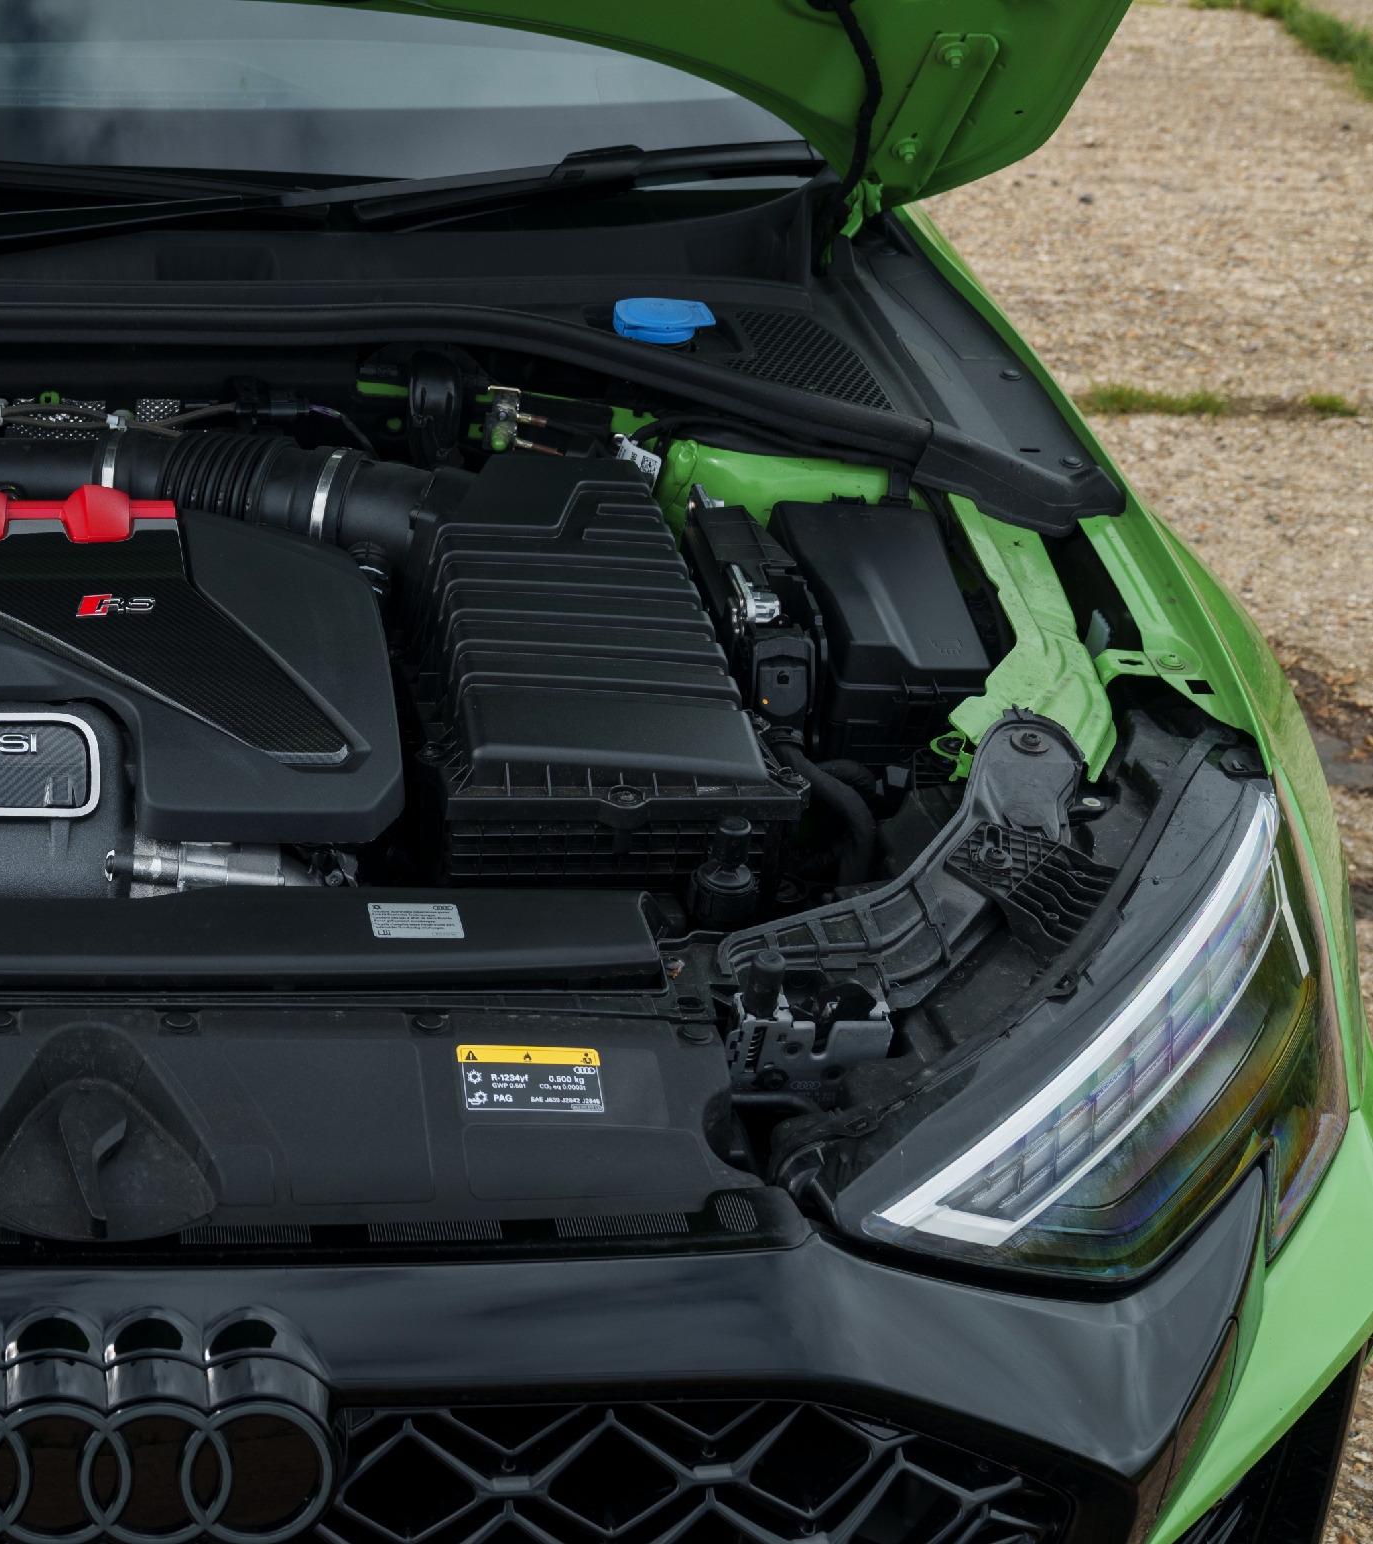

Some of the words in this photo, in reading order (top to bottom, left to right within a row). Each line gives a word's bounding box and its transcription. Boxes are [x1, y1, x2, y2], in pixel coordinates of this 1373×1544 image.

[94, 595, 156, 614] RS
[491, 1073, 529, 1083] R-1234yf
[548, 1075, 572, 1083] 0.500
[574, 1075, 585, 1085] kg
[493, 1094, 513, 1102] PAG
